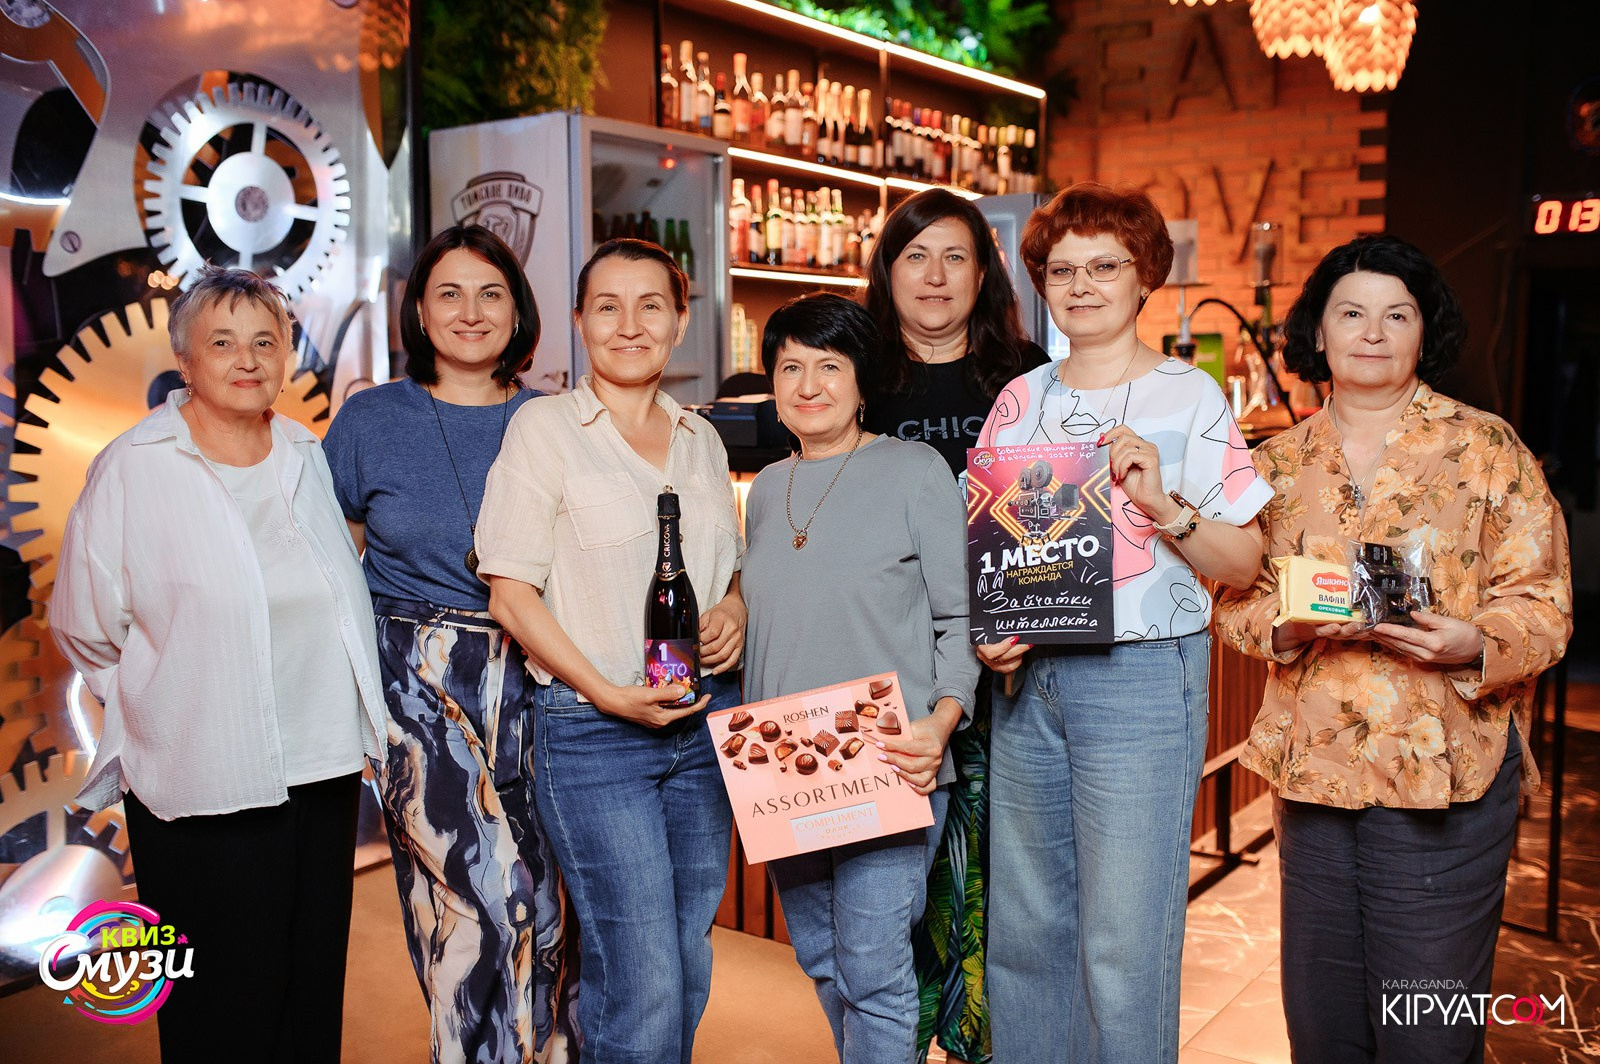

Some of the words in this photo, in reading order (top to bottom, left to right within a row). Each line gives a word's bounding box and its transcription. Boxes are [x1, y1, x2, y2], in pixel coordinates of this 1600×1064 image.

[897, 416, 985, 441] CHIC
[663, 523, 671, 558] CRICOVA
[980, 552, 995, 574] 1
[1001, 535, 1100, 571] МЕСТО
[1006, 561, 1074, 578] НАГРАЖДАЕТСЯ
[1018, 572, 1062, 585] КОМАНДА
[983, 590, 1092, 612] Зайчатки
[1318, 594, 1346, 604] ВАФЛИ
[995, 613, 1098, 630] интеллекта
[659, 642, 668, 661] 1
[783, 705, 829, 724] ROSHEN
[752, 770, 902, 818] ASSORTMENT
[796, 807, 873, 832] COMPLIMENT
